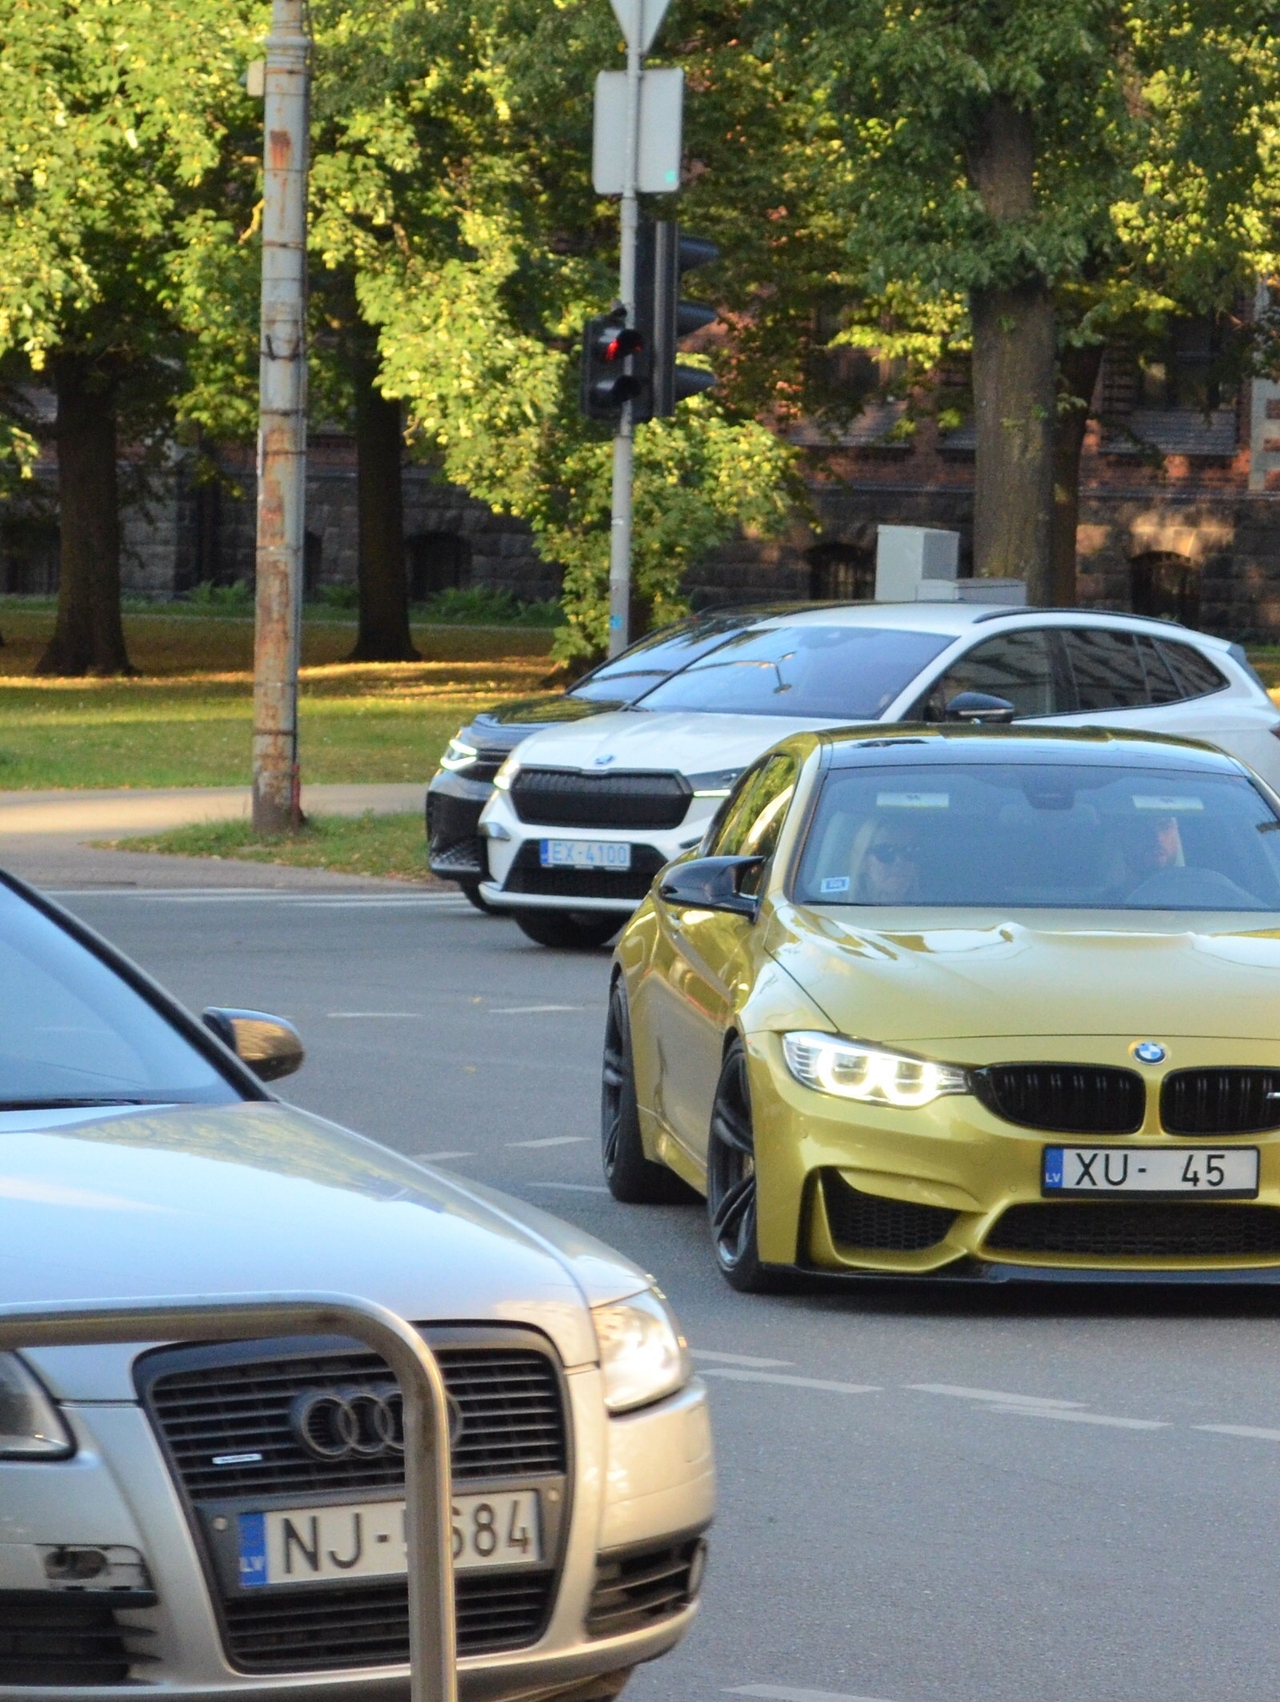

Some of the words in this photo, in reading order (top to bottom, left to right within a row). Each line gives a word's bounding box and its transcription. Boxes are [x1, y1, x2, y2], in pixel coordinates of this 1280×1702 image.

[552, 842, 627, 863] EX-4100
[1045, 1173, 1061, 1183] LV
[1075, 1153, 1147, 1186] XU-
[1181, 1154, 1226, 1187] 45
[281, 1500, 529, 1574] NJ-684
[239, 1556, 264, 1573] LV
